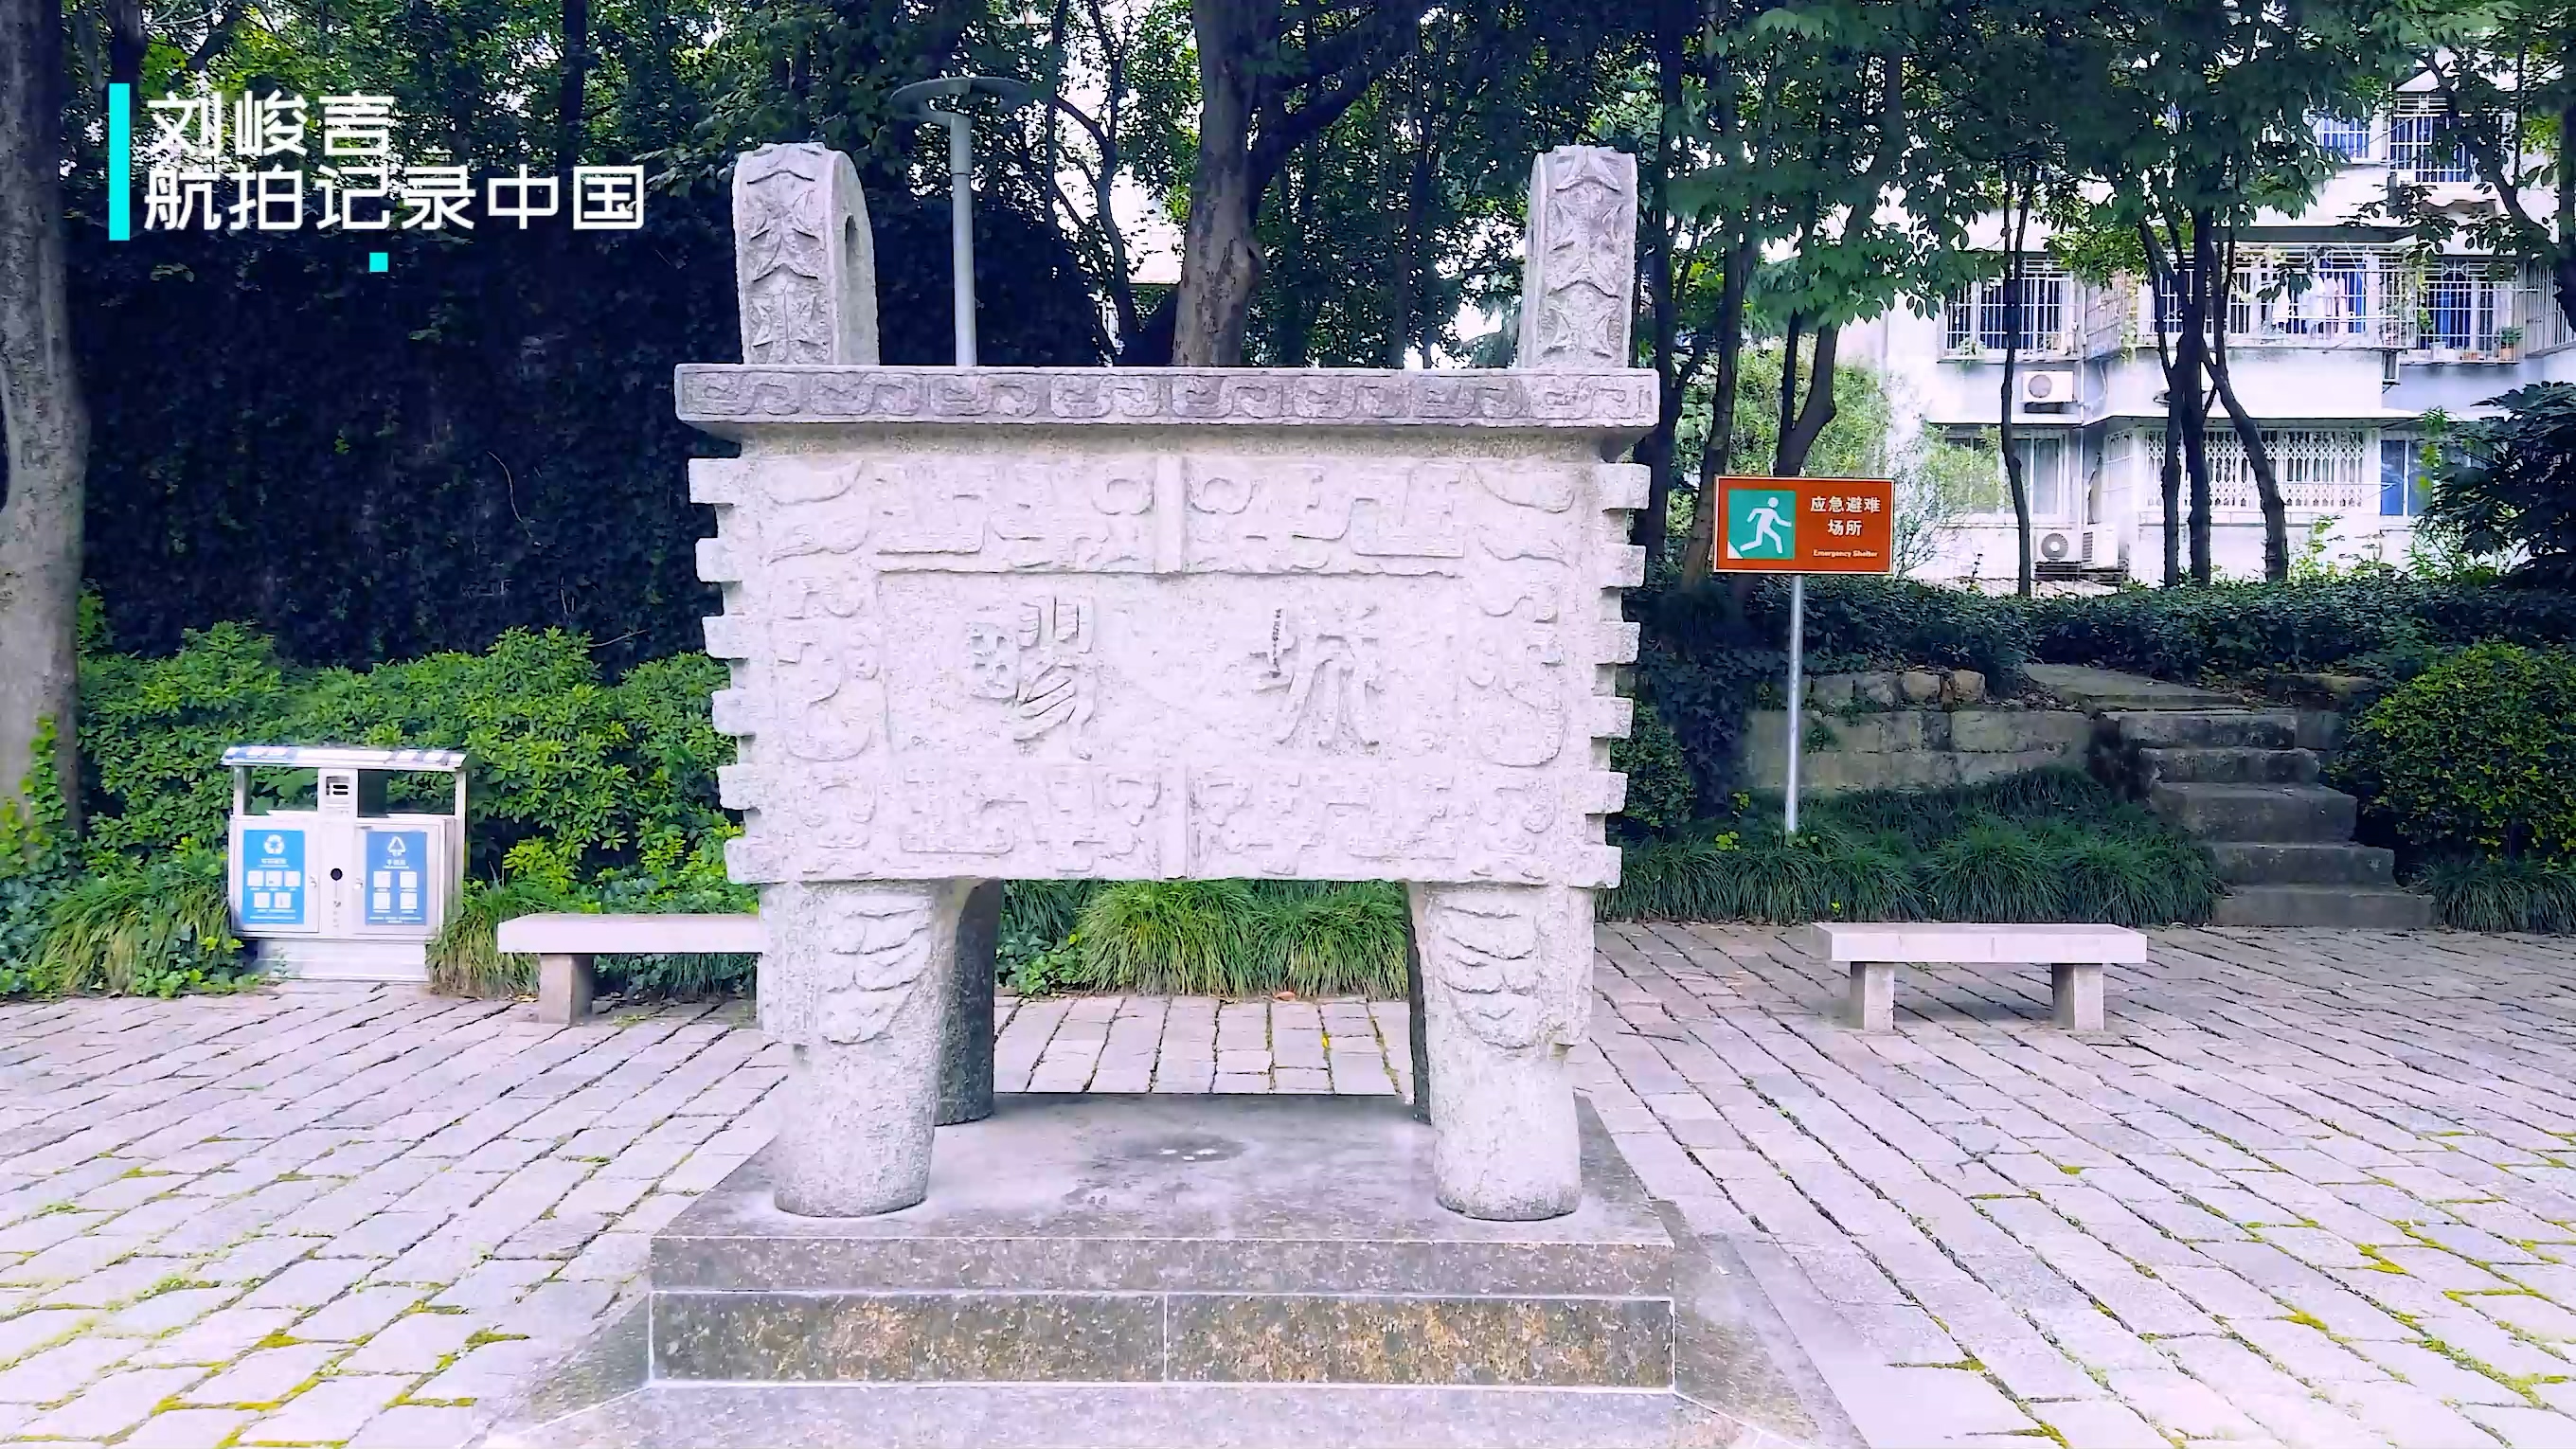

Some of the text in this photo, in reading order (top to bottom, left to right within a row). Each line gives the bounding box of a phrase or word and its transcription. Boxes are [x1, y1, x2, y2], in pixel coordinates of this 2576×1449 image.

[1810, 495, 1882, 513] 应急避难
[1827, 519, 1863, 536] 场所
[1813, 548, 1879, 558] Emergency Shelter
